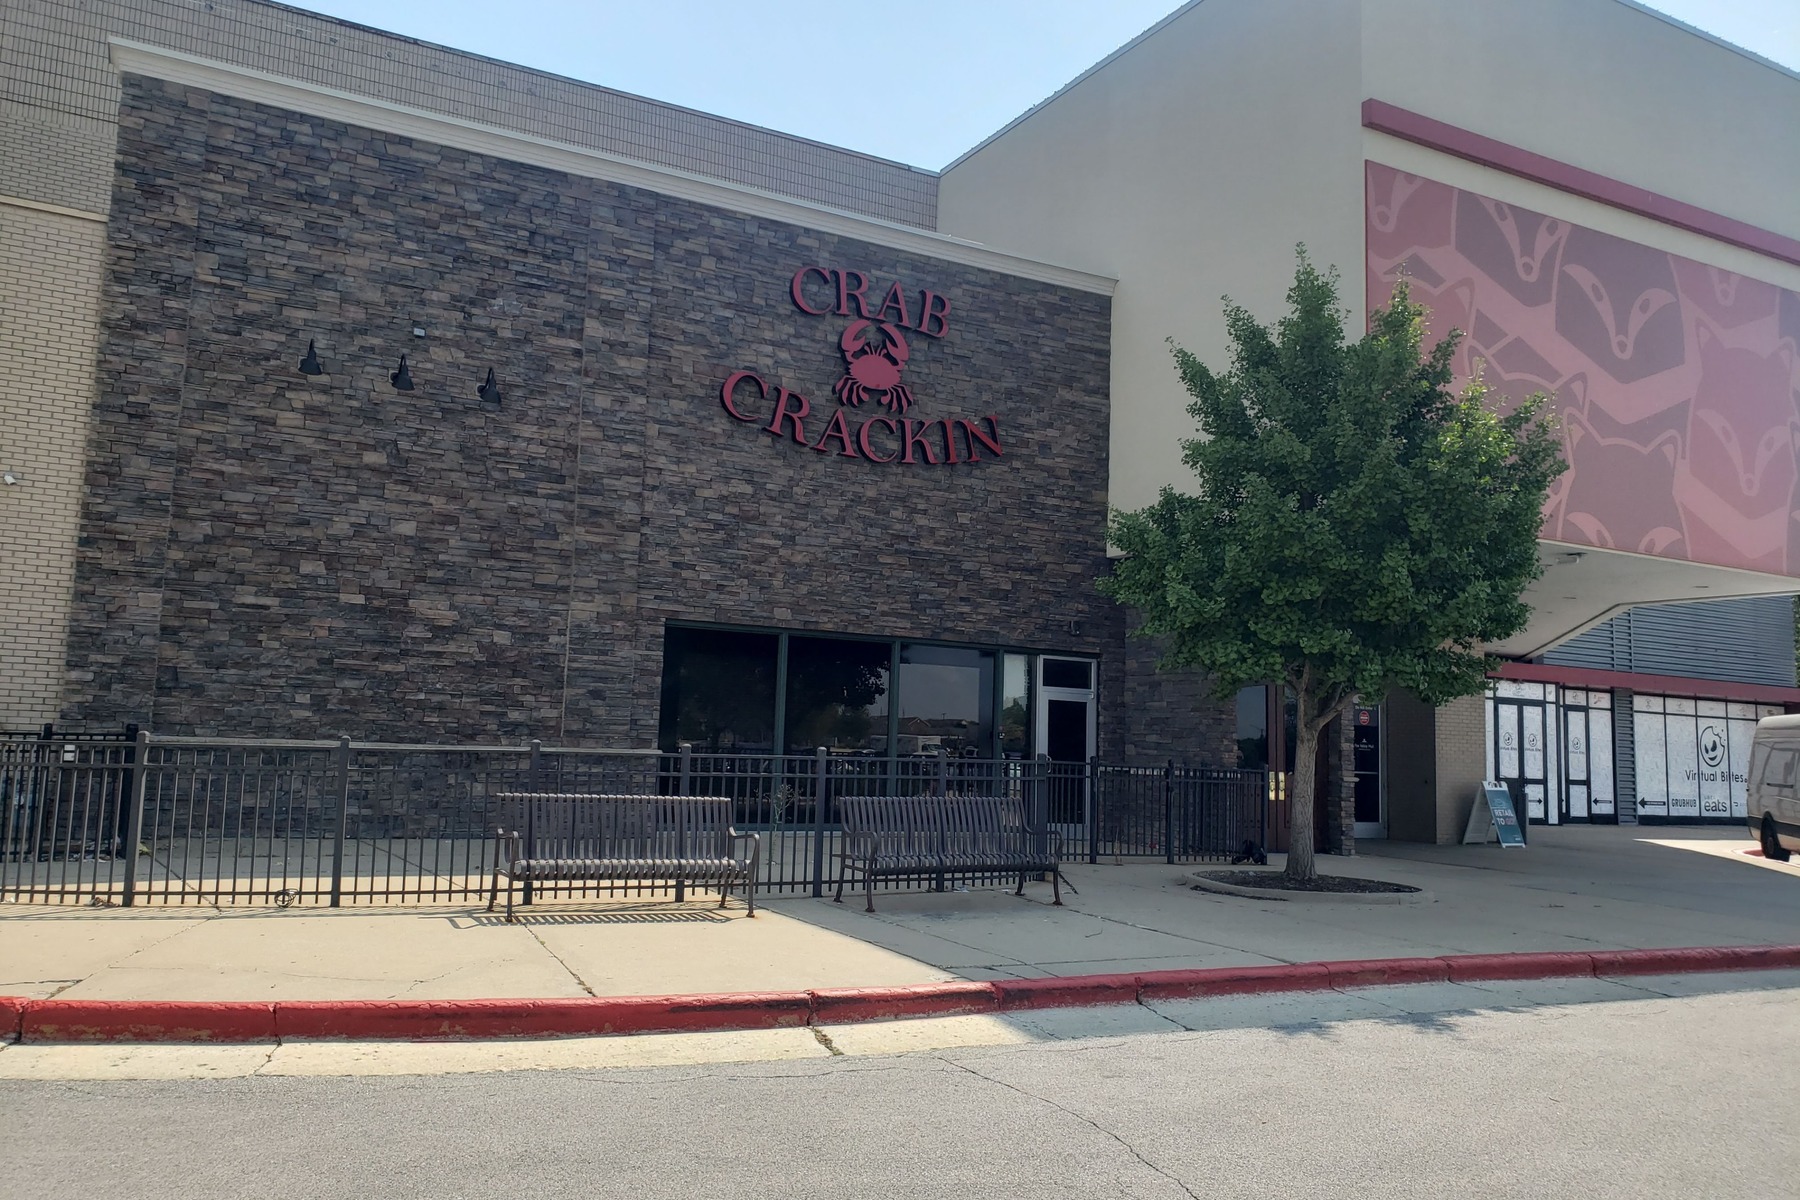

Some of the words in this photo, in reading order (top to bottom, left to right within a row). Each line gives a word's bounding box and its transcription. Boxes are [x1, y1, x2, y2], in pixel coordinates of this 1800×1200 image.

[790, 266, 951, 338] CRAB
[720, 371, 1003, 464] CRACKIN
[1685, 770, 1718, 782] Virtual
[1671, 798, 1697, 808] GRUBHUB
[1704, 800, 1728, 812] eats
